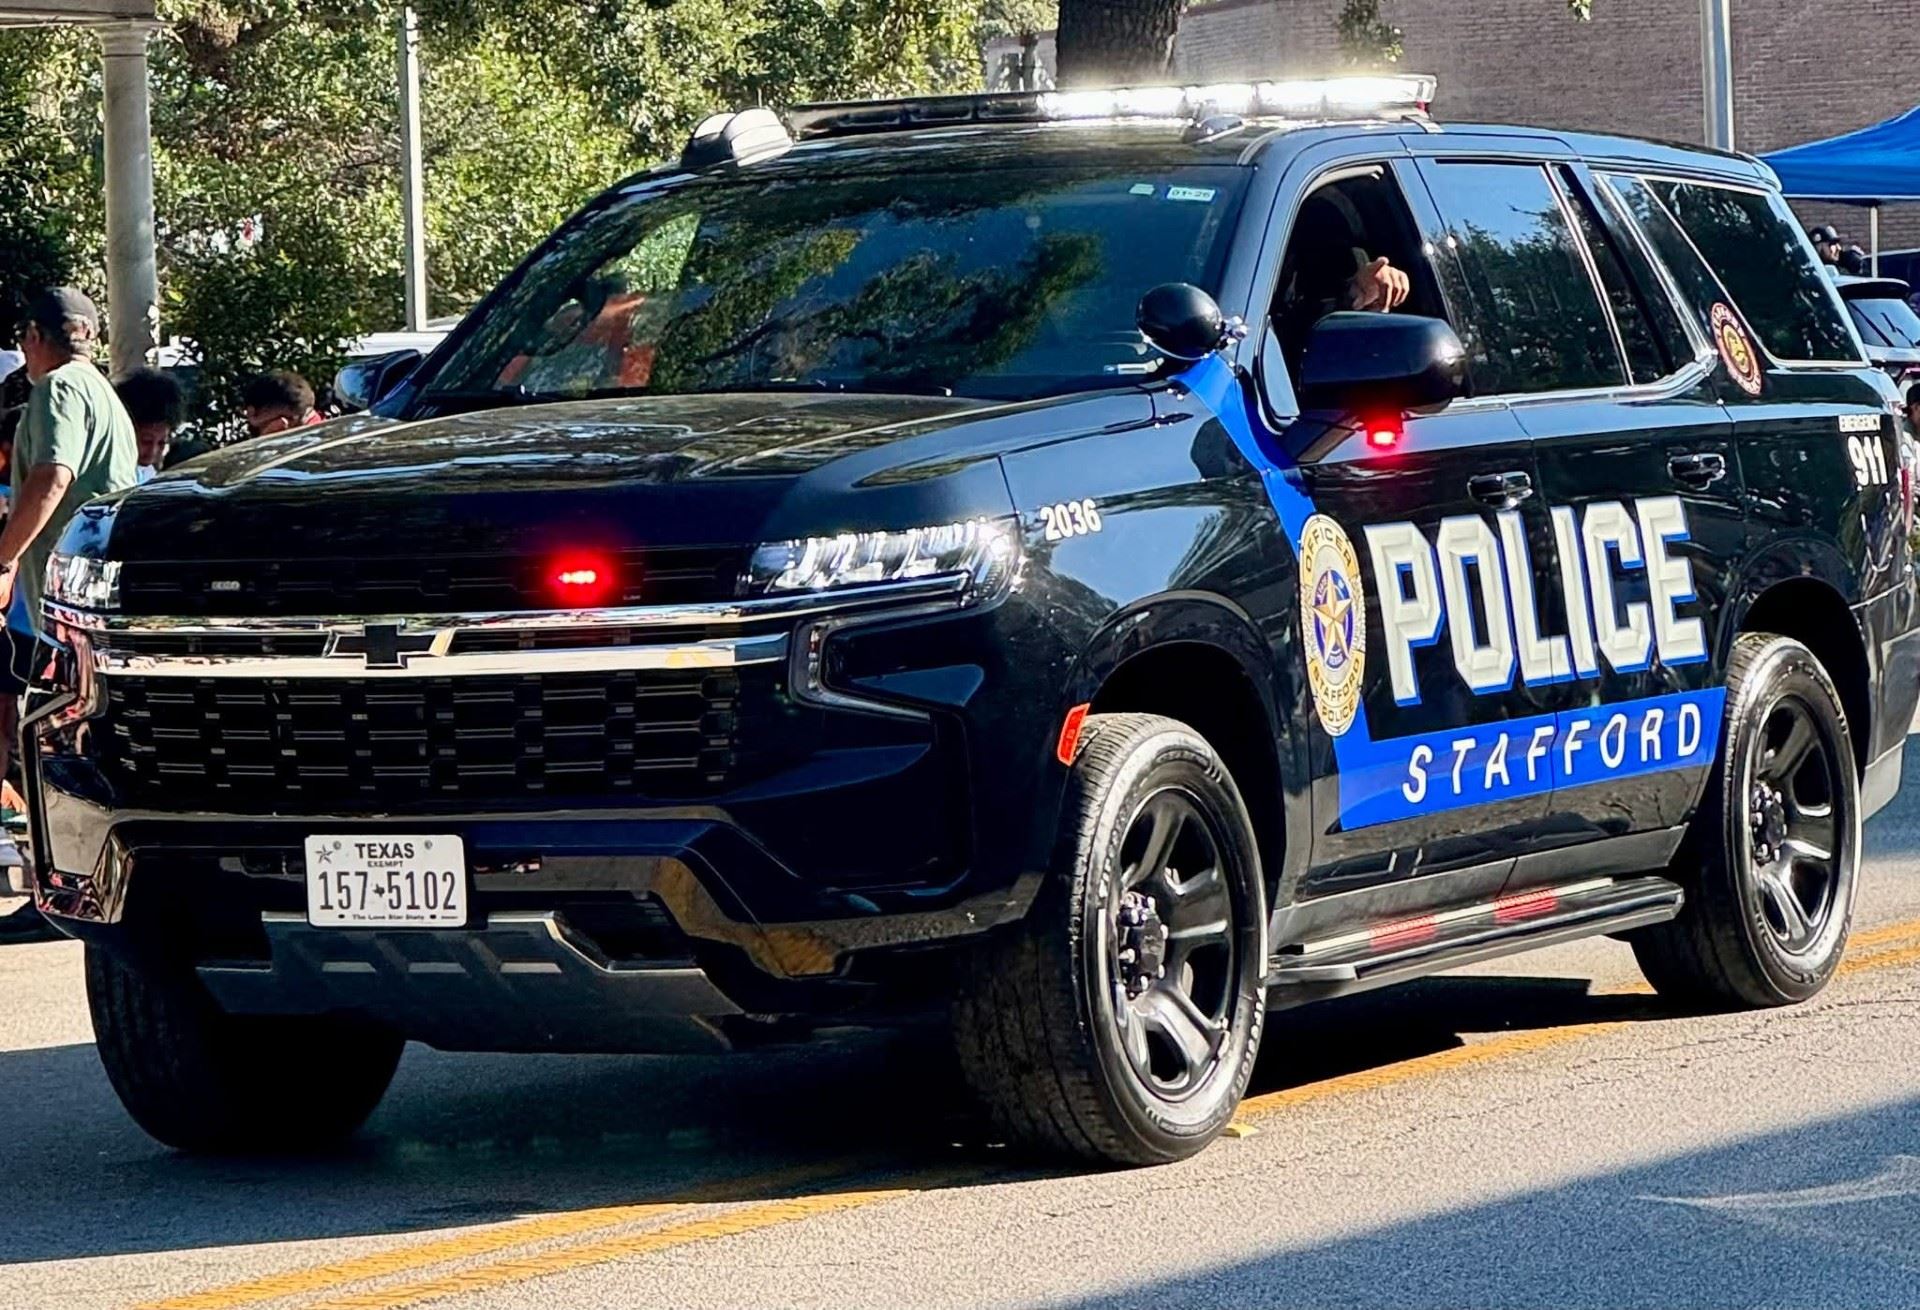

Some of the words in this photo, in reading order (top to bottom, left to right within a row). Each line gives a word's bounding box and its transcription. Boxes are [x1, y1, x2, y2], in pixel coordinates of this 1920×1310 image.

[1847, 435, 1888, 486] 911
[1040, 498, 1102, 541] 2036
[1305, 527, 1352, 572] OFFICER
[1363, 495, 1708, 706] POLICE
[1313, 657, 1360, 701] STAFFORD
[1321, 698, 1356, 722] POLICE
[1401, 702, 1701, 803] STAFFORD
[355, 843, 414, 859] TEXAS
